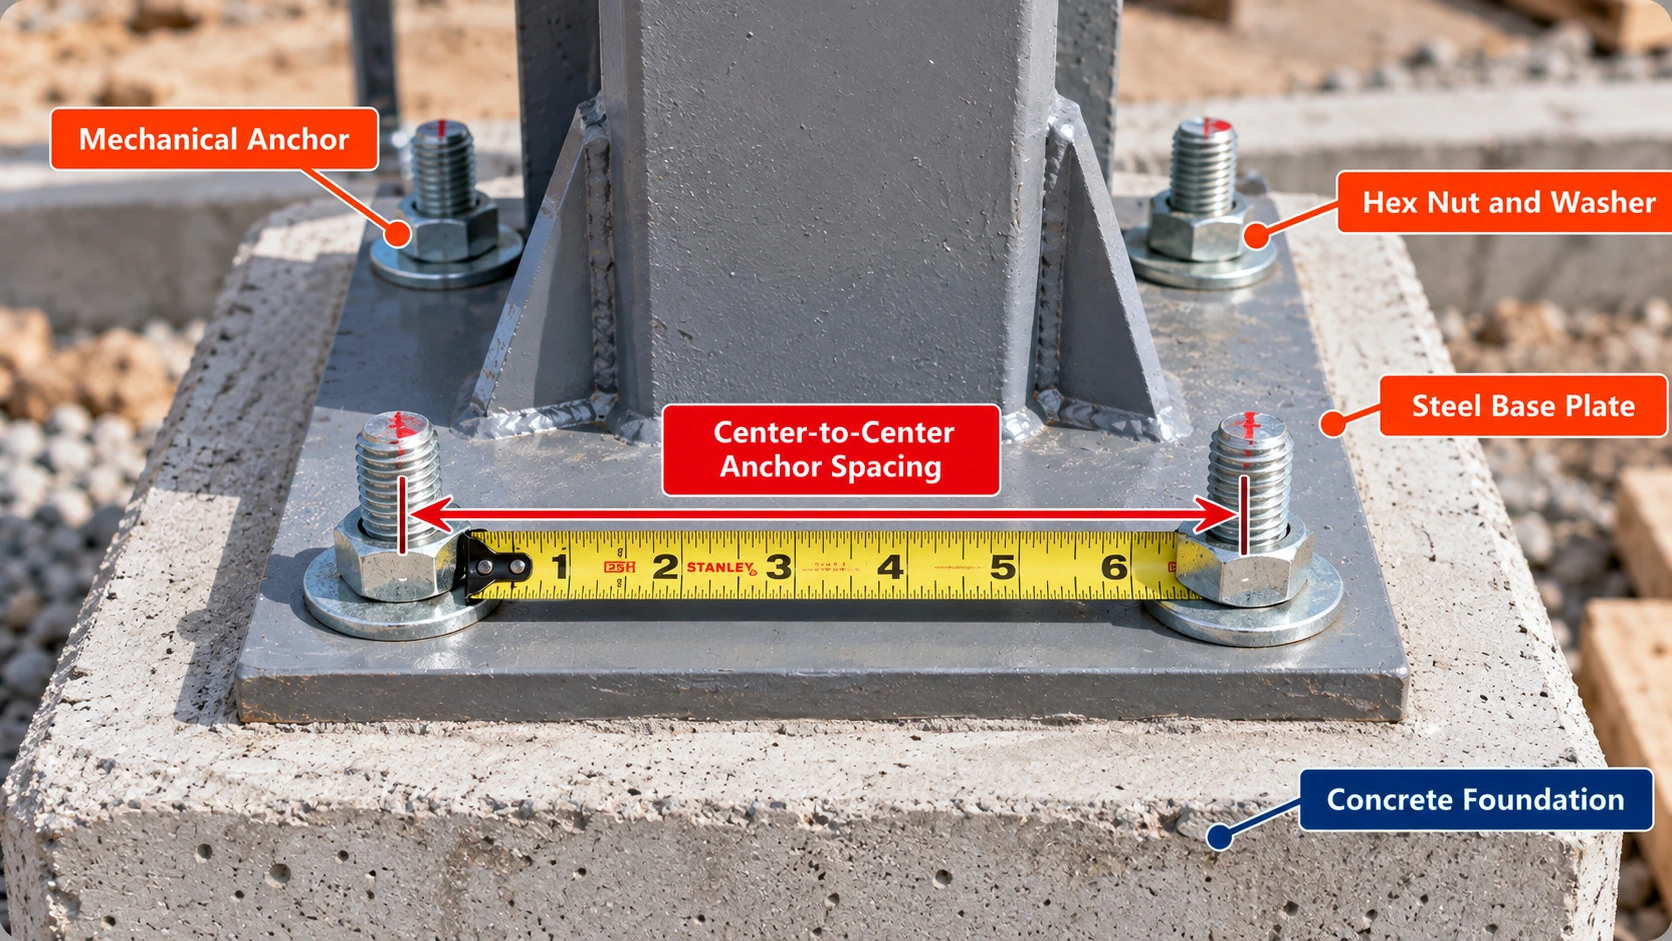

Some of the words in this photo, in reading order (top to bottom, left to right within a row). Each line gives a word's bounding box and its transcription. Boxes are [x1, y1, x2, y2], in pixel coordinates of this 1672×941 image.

[552, 554, 568, 579] 1
[652, 554, 679, 579] 2
[687, 562, 754, 573] STANLEY
[765, 554, 792, 579] 3
[877, 554, 904, 580] 4
[990, 554, 1016, 580] 5
[1101, 554, 1128, 580] 6
